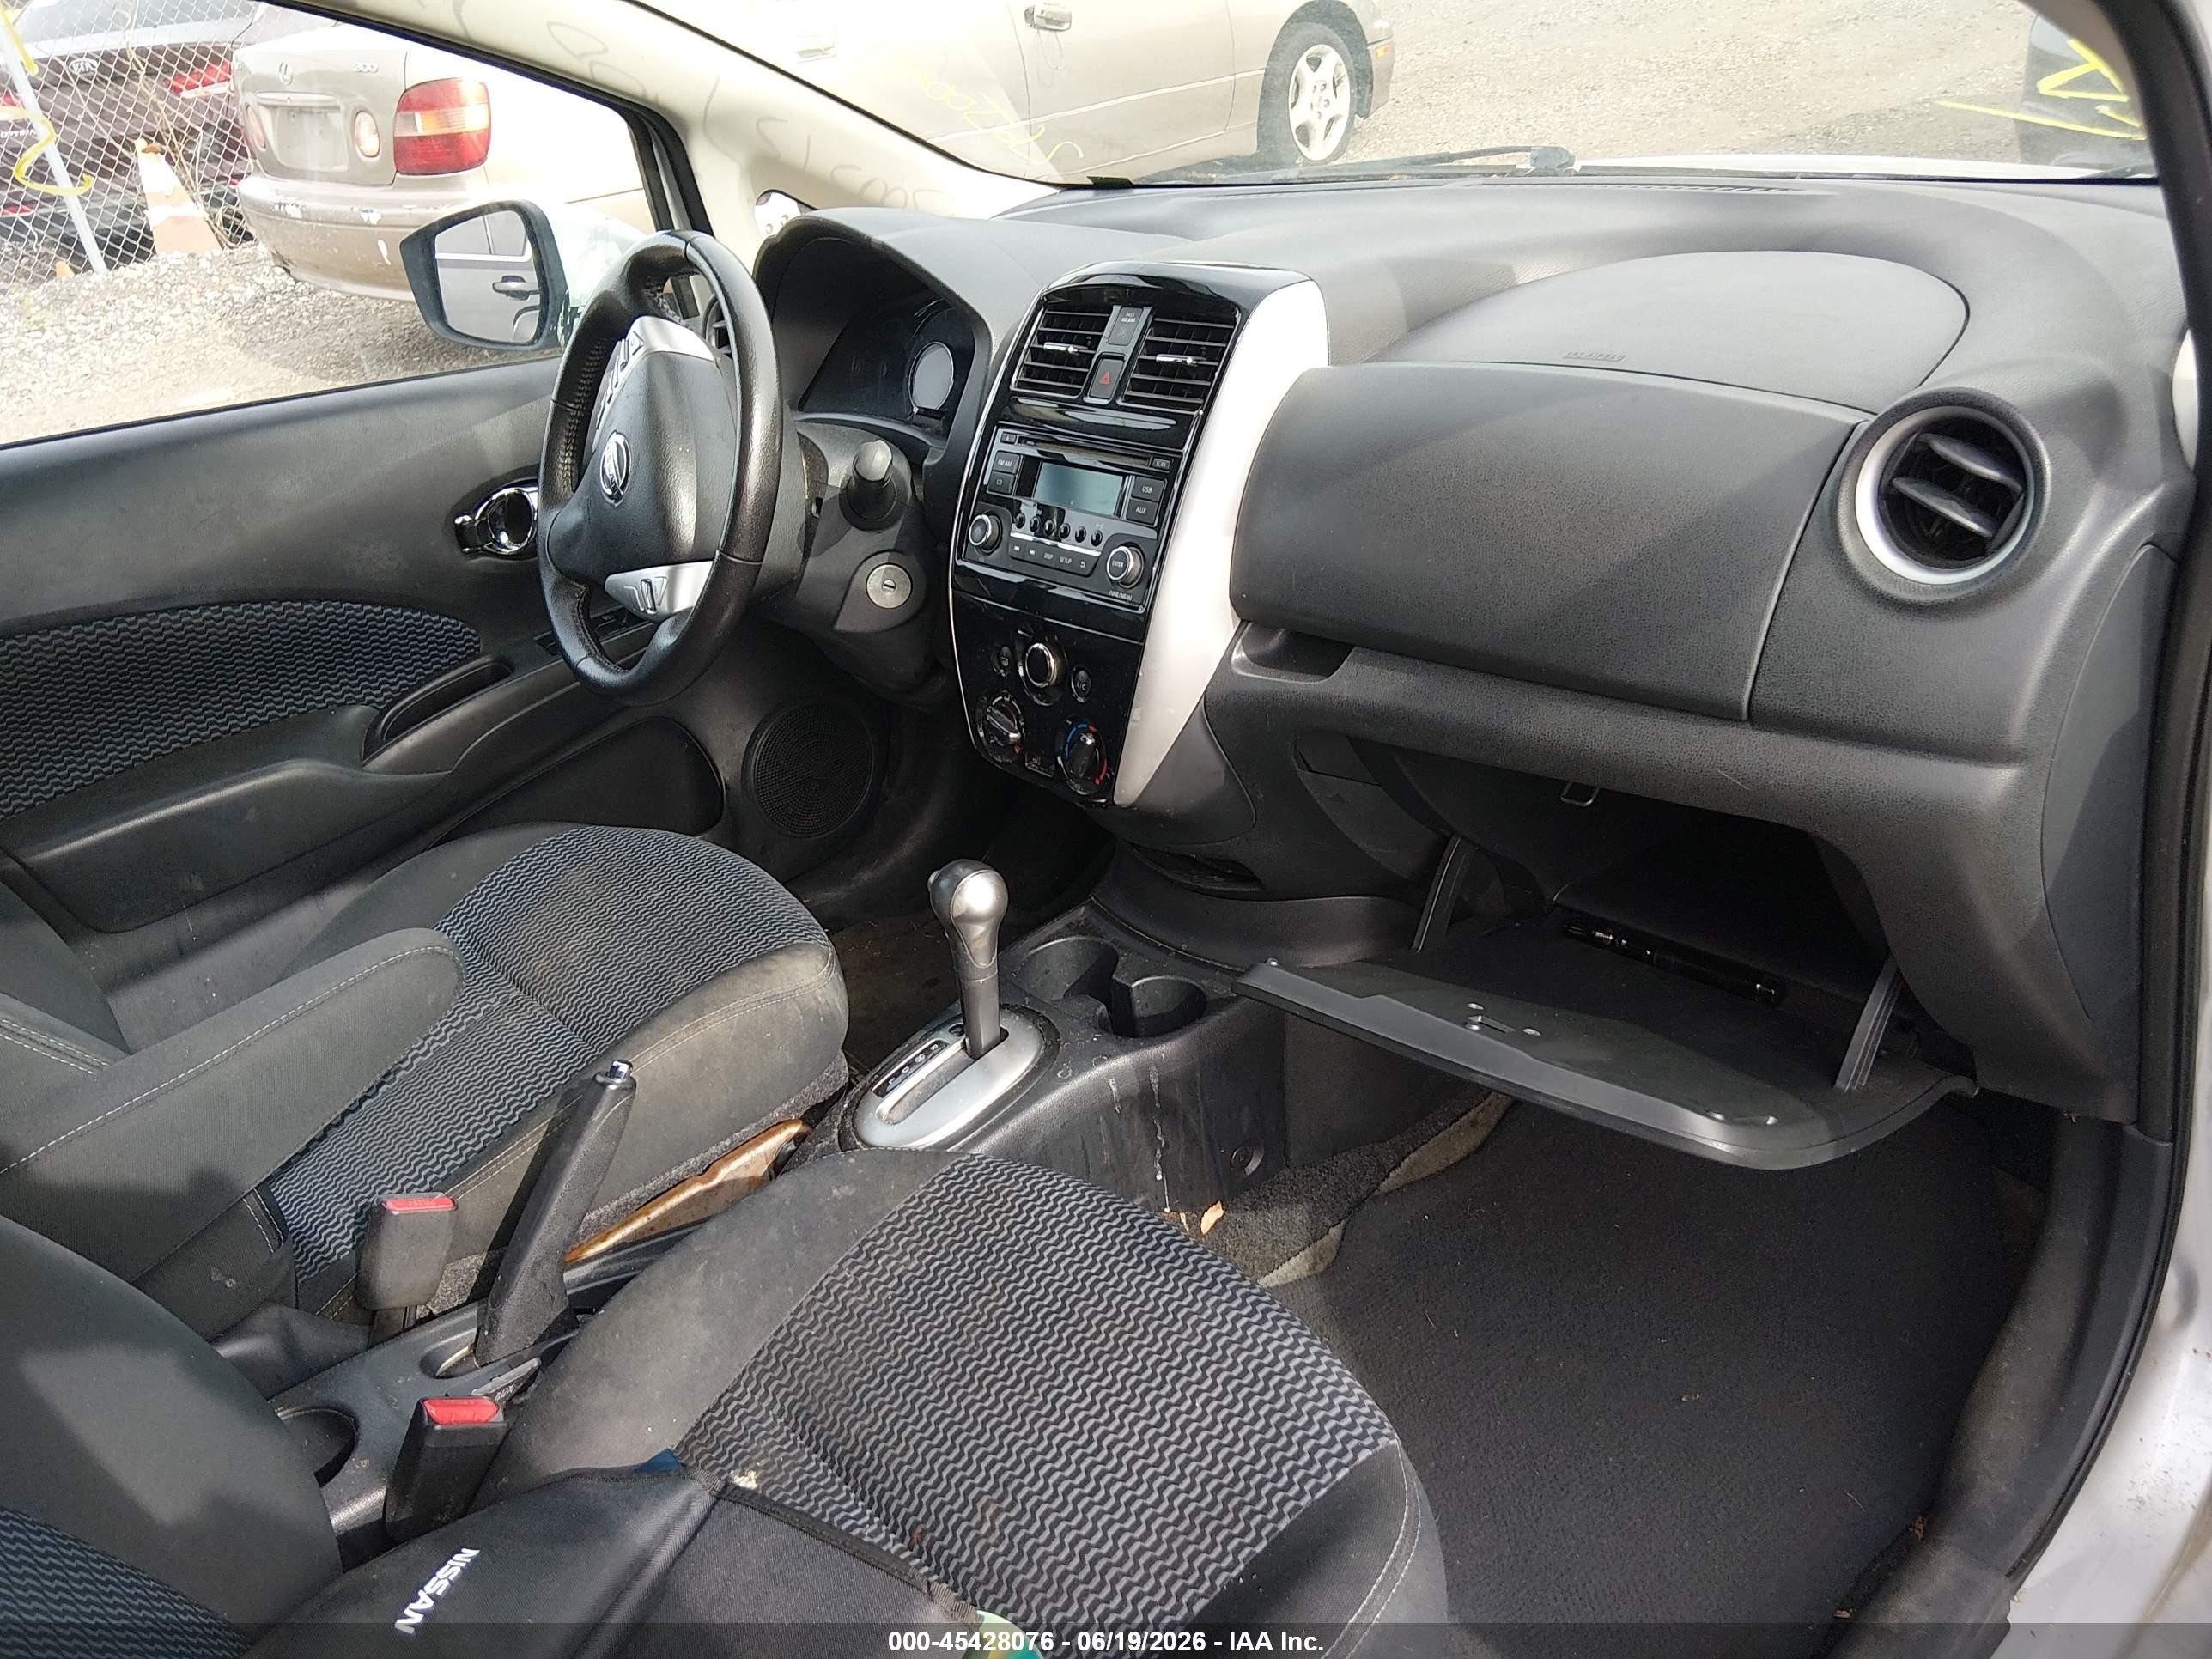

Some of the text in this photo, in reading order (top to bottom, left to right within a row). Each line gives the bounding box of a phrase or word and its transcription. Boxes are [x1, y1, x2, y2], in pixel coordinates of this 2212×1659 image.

[1141, 485, 1152, 495] USB
[1135, 506, 1147, 515] AUX
[394, 1547, 481, 1635] NISSAN
